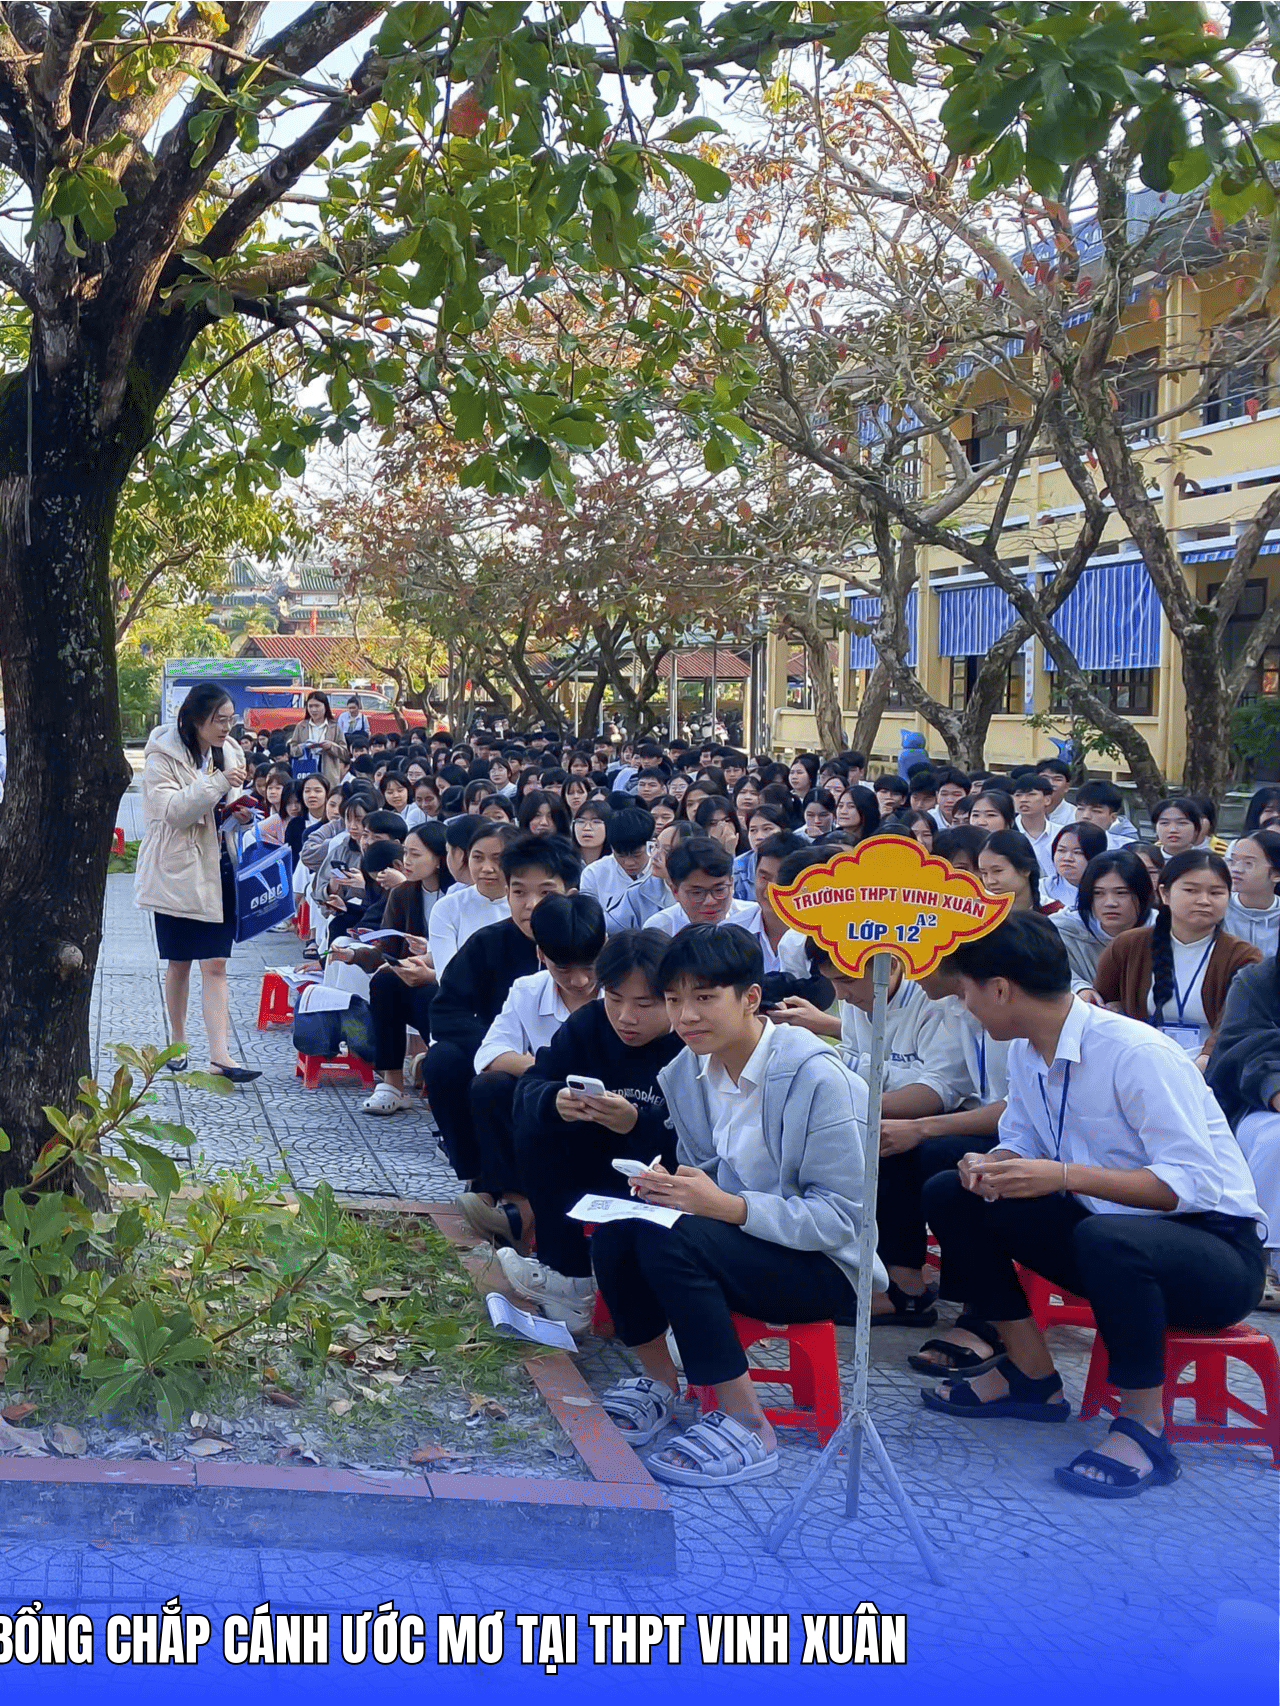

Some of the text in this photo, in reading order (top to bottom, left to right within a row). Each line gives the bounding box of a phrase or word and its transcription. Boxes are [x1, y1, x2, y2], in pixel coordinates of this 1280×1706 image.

[793, 886, 985, 918] TRƯỜNG THPT VINH XUÂN
[848, 918, 888, 941] LỚP
